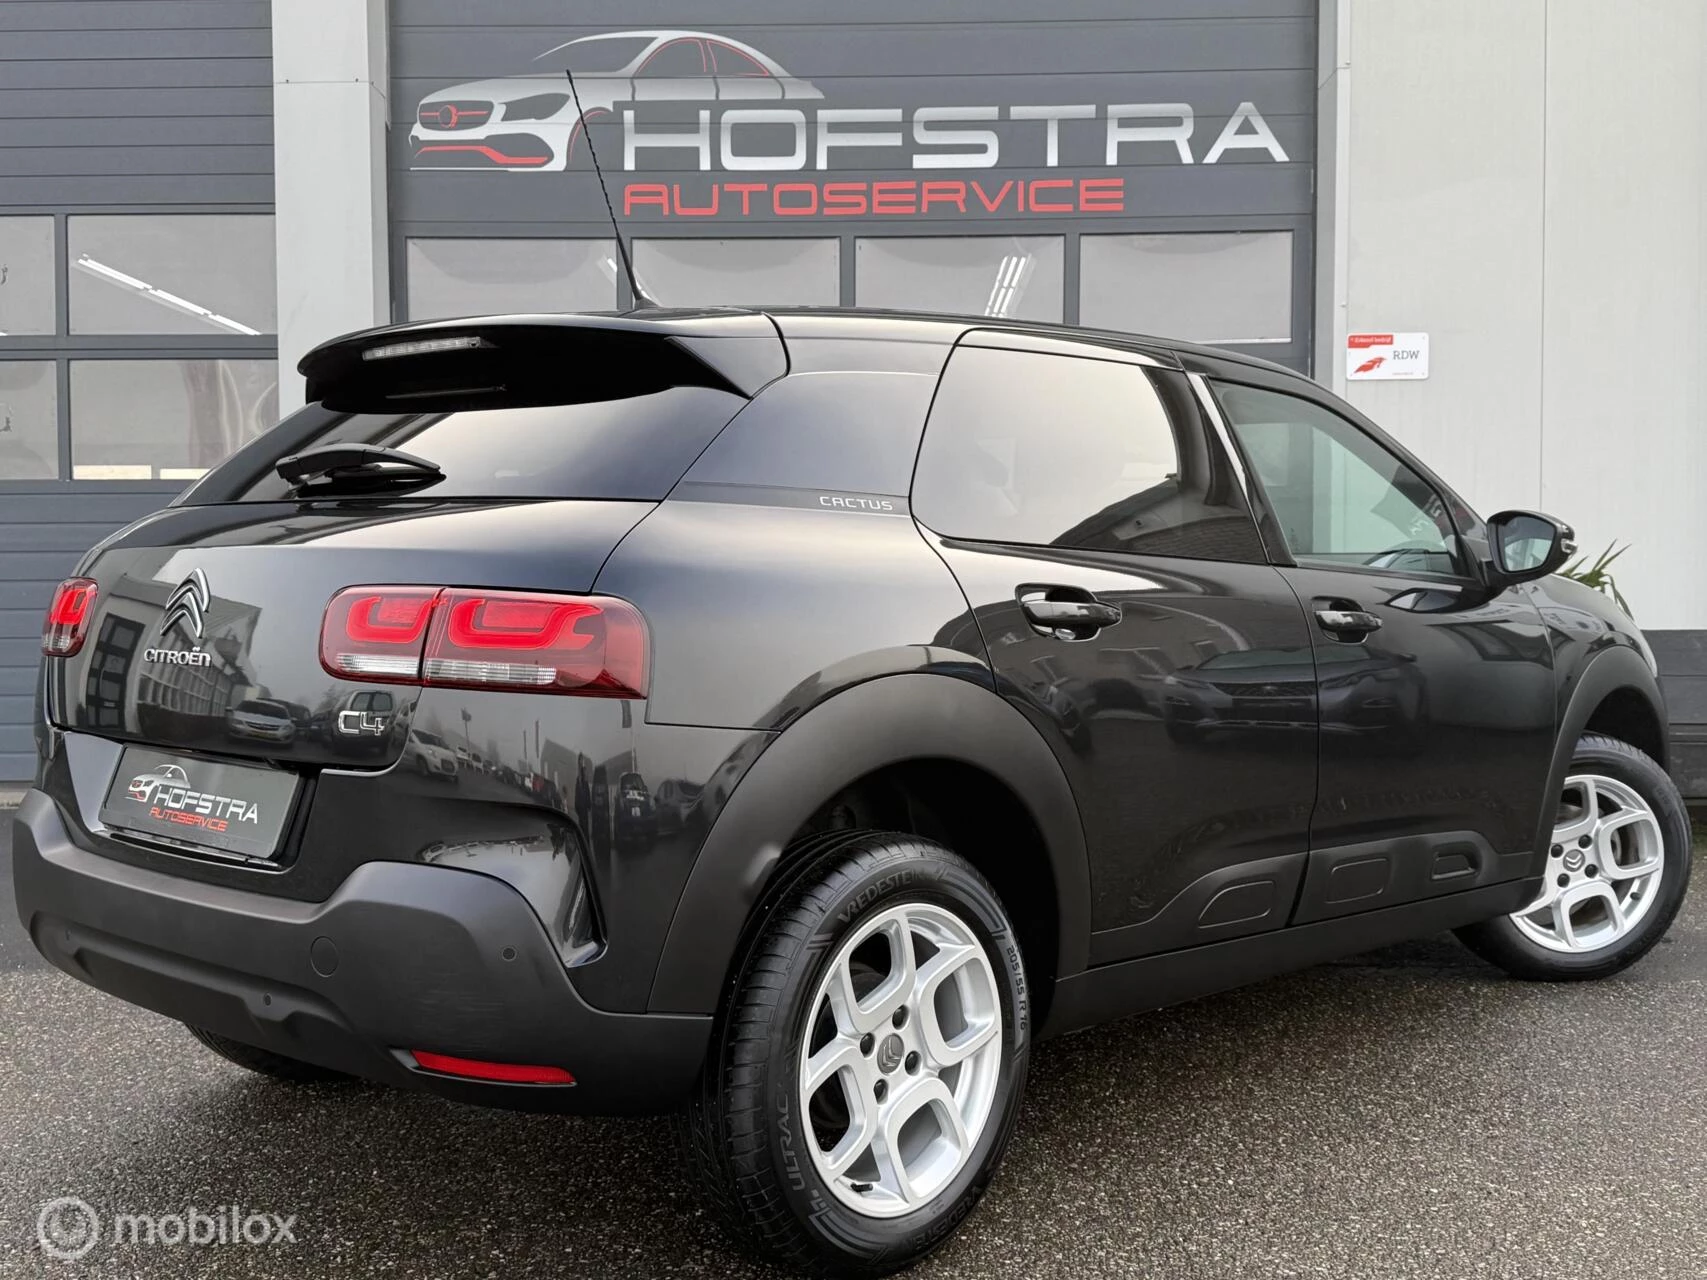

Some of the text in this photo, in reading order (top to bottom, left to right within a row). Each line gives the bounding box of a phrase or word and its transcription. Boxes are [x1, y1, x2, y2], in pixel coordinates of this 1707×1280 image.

[622, 101, 1290, 172] HOFSTRA
[623, 178, 1125, 216] AUTOSERVICE
[1392, 349, 1420, 361] RDW
[819, 496, 893, 511] CACTUS
[338, 710, 385, 736] C4
[149, 806, 229, 832] AUTOSERVICE
[153, 785, 258, 825] HOFSTRA
[777, 1093, 806, 1191] ULTRAC
